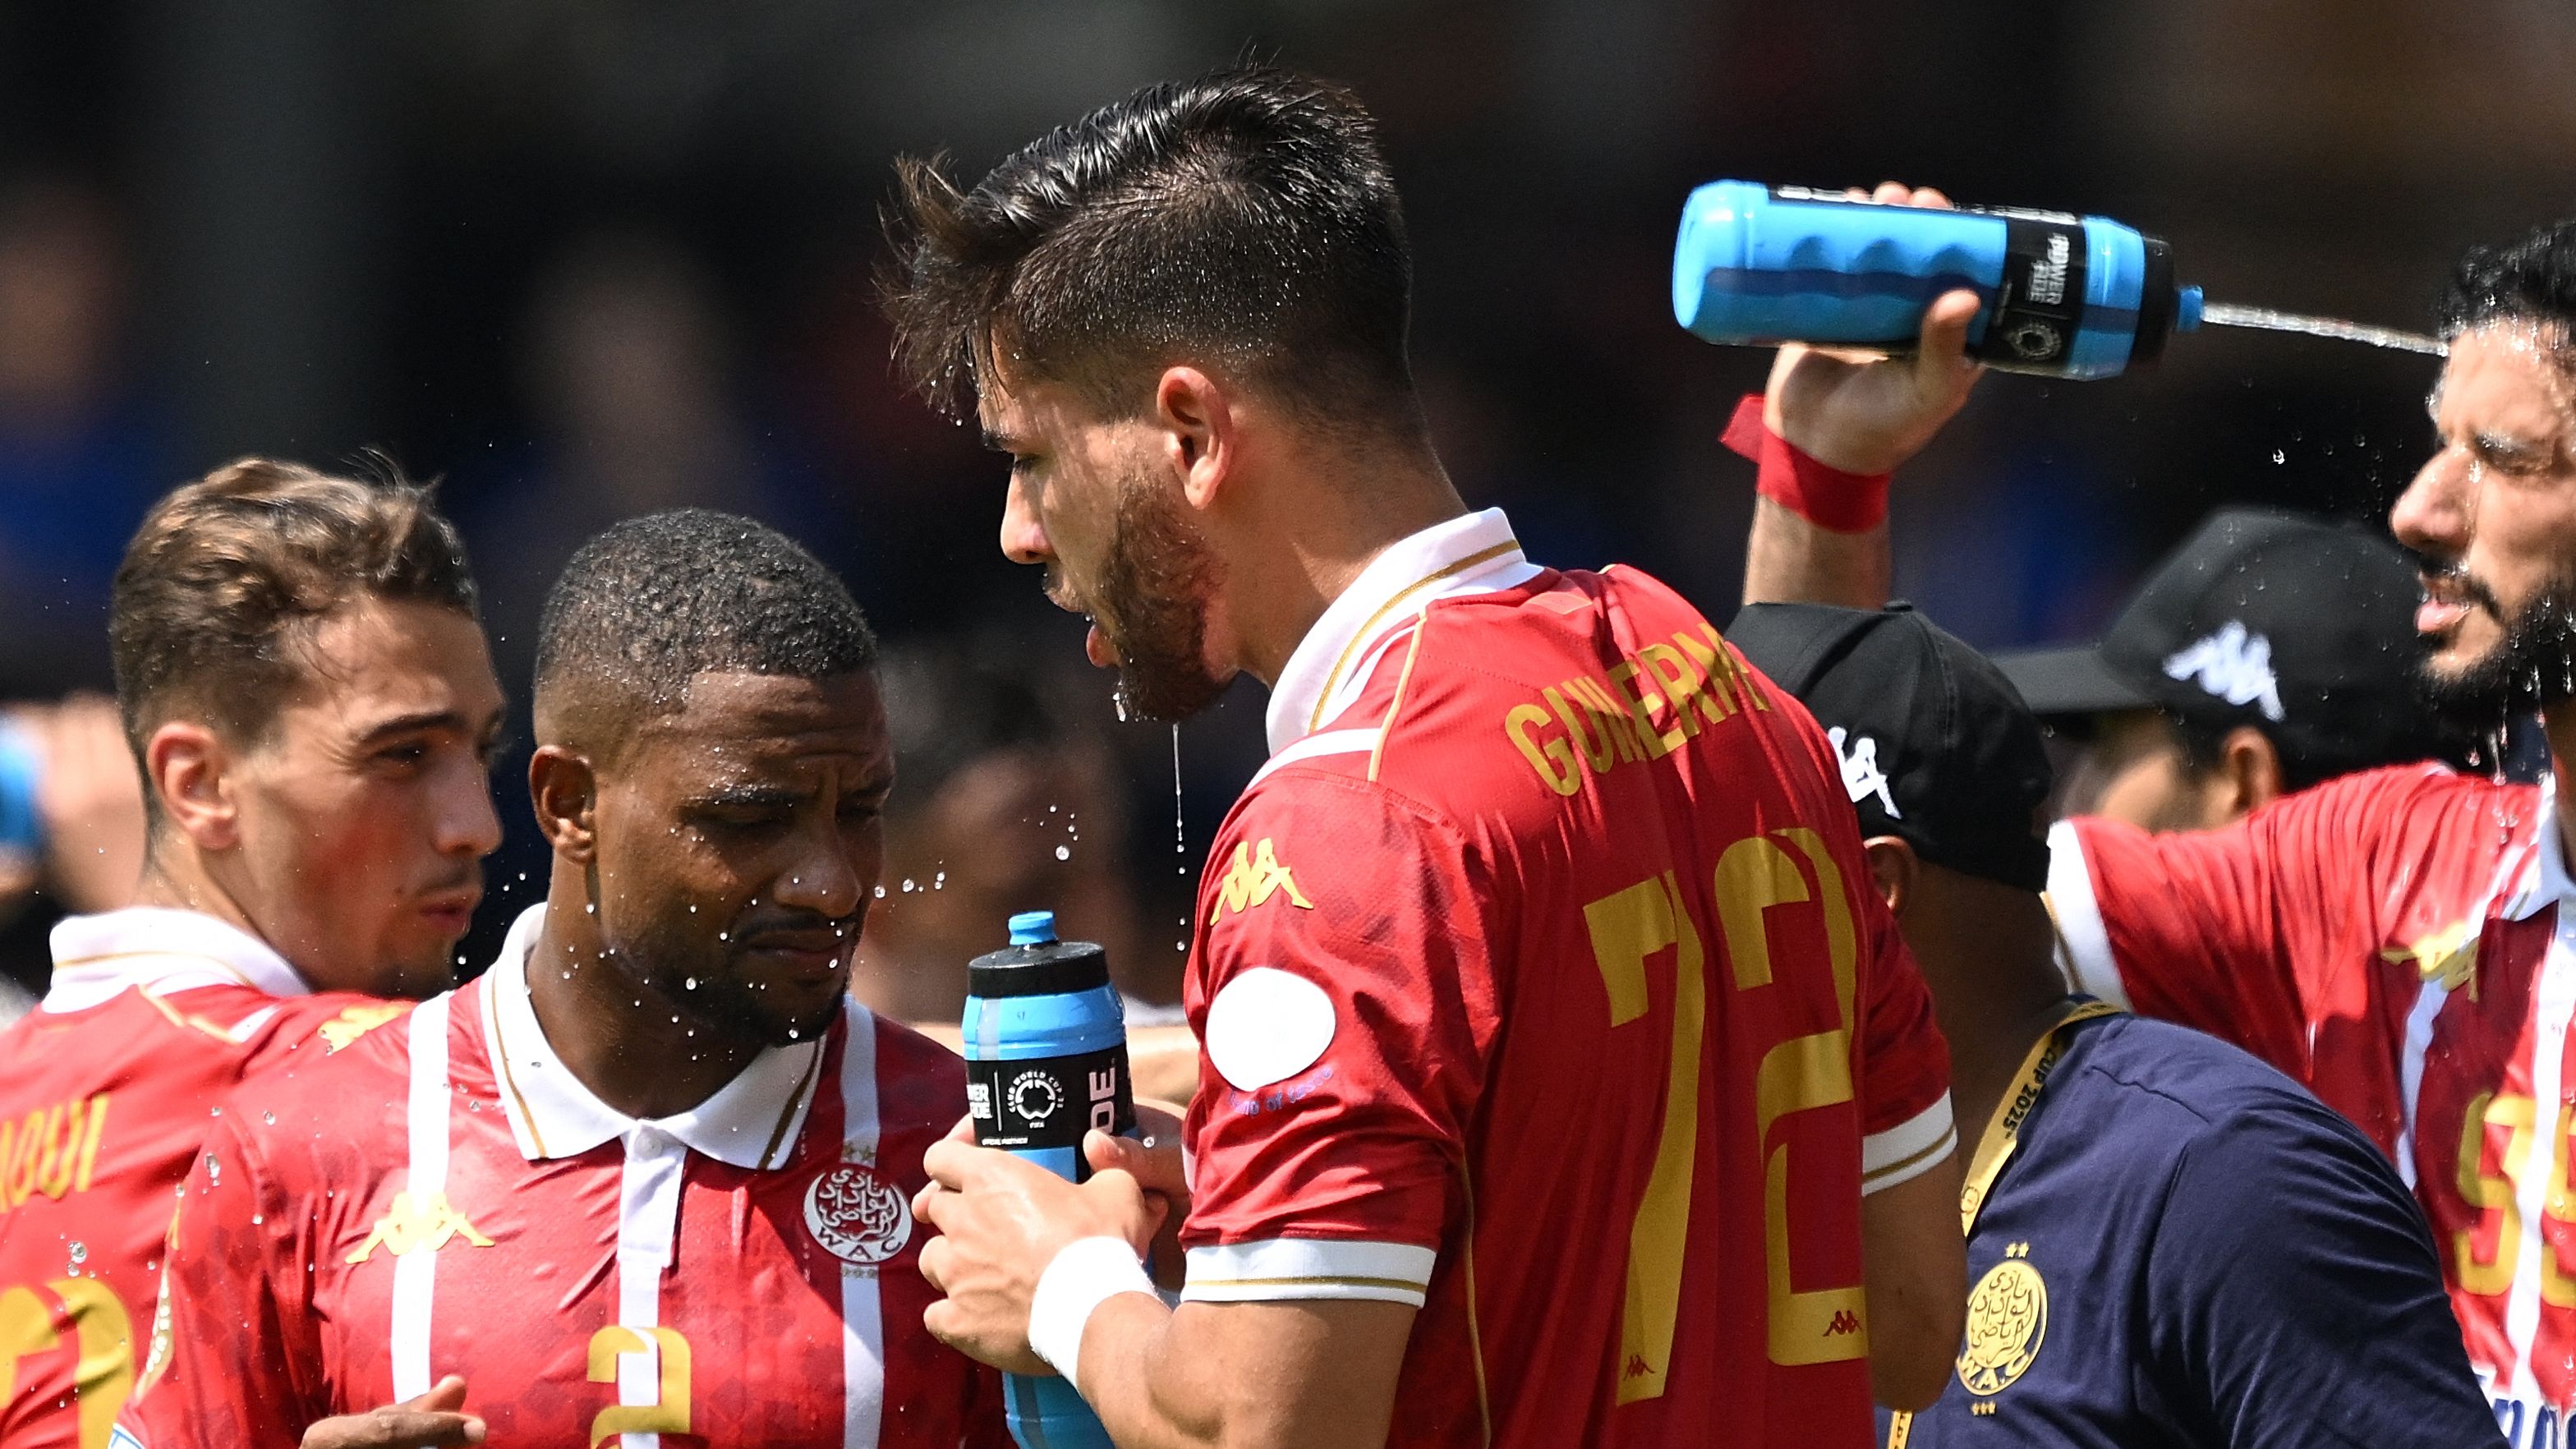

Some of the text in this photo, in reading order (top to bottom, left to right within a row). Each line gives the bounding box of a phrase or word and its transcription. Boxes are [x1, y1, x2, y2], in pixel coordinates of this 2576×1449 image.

[1007, 1086, 1016, 1113] CLUB
[1013, 1070, 1046, 1085] WORLD
[1048, 1077, 1063, 1093] CUP
[1584, 827, 1870, 1406] 72
